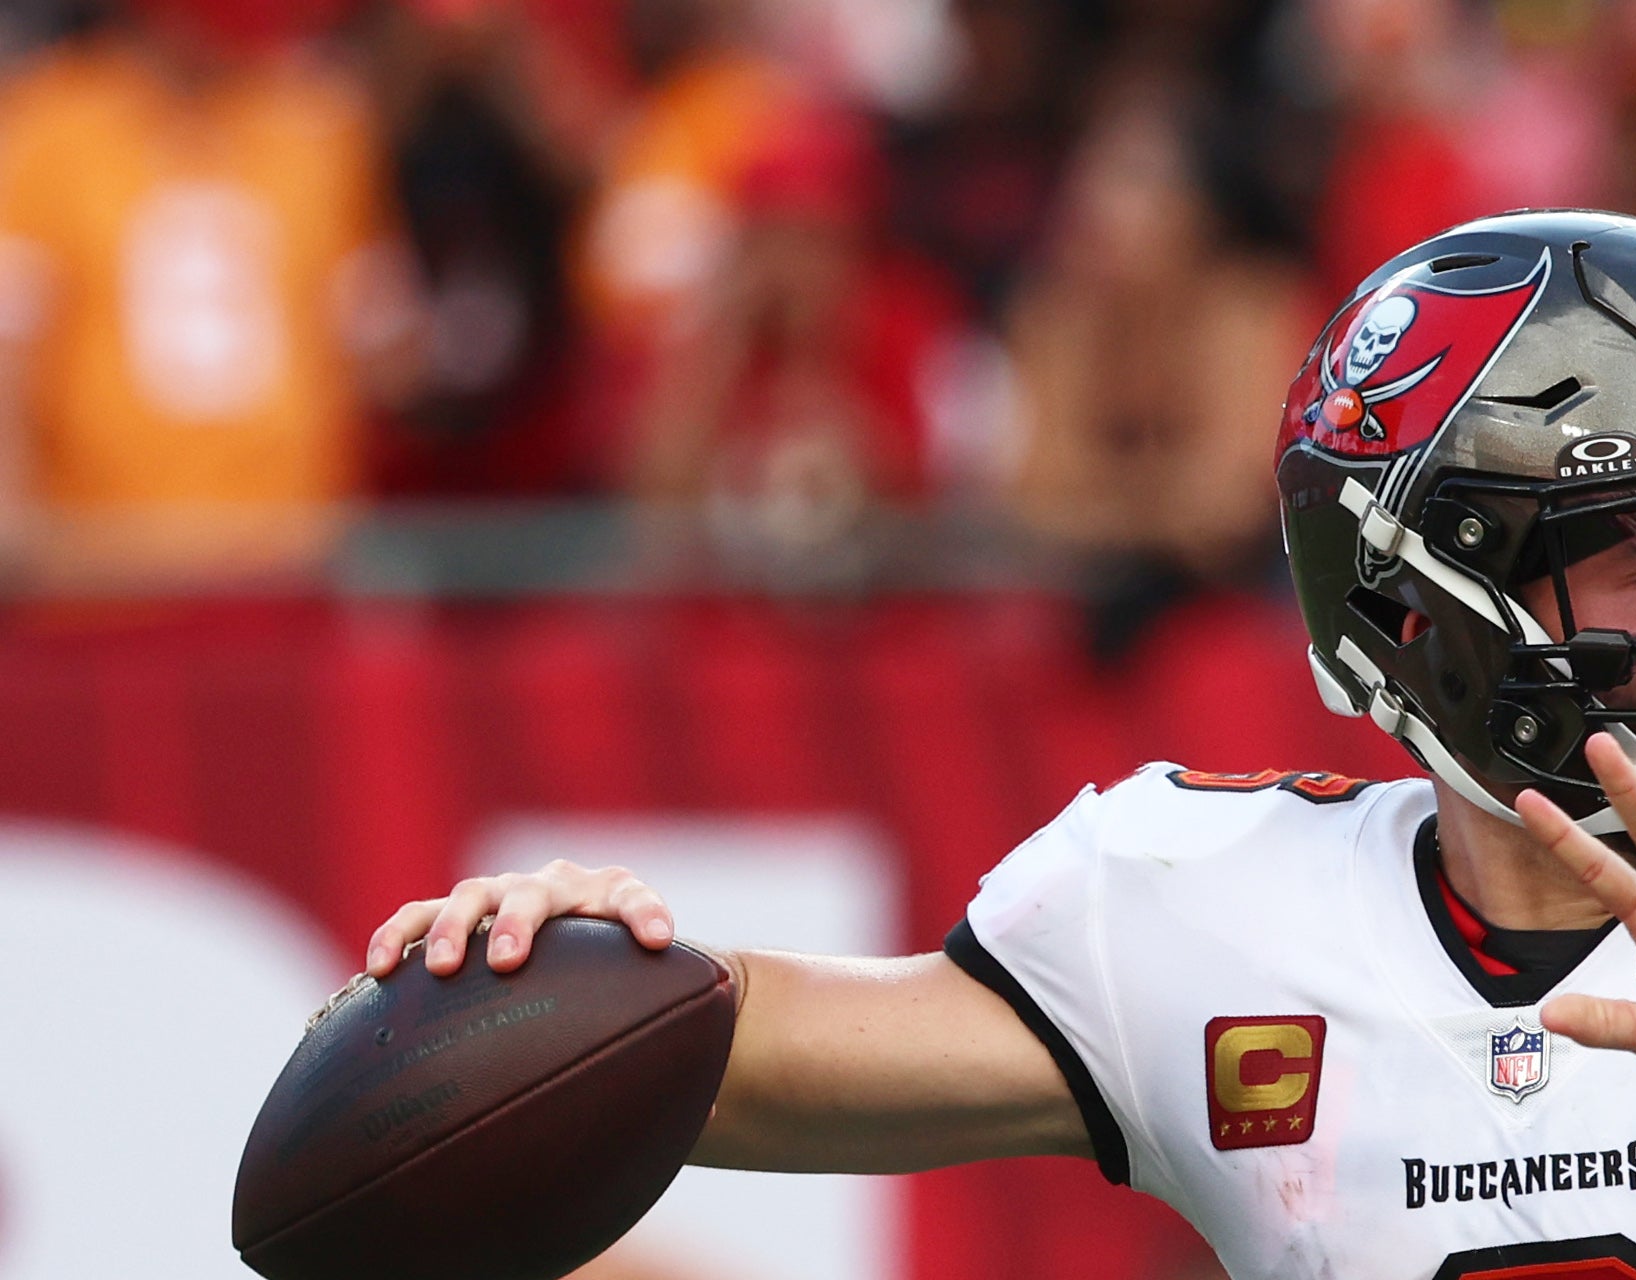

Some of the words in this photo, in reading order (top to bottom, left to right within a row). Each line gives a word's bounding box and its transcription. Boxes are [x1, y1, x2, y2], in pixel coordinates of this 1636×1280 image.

[465, 995, 559, 1040] LEAGUE
[1213, 1023, 1313, 1114] C
[1495, 1054, 1539, 1087] NFL
